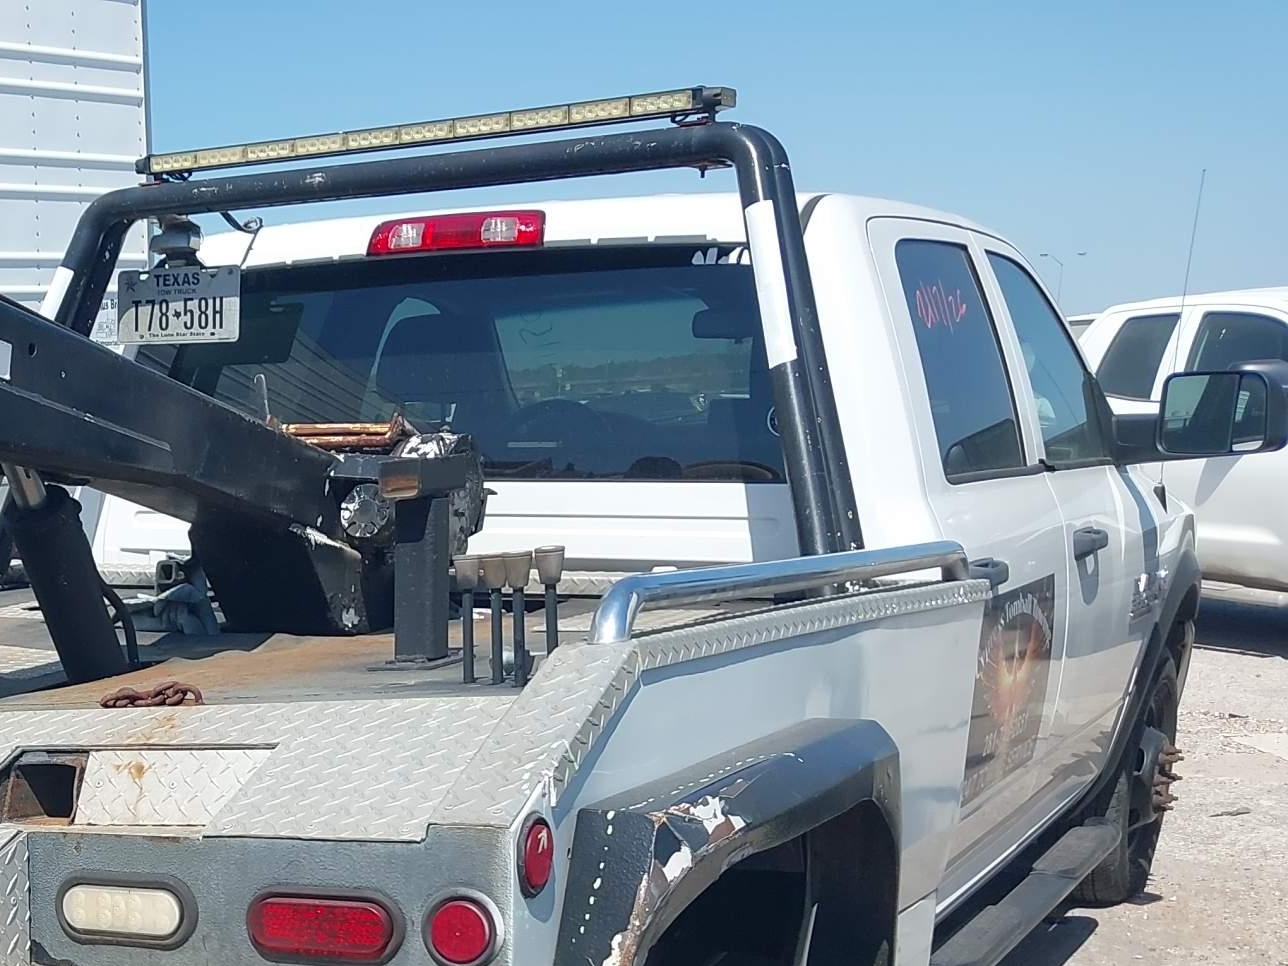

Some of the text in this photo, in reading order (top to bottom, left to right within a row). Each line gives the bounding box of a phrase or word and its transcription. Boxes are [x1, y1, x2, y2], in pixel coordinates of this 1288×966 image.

[154, 272, 200, 288] TEXAS
[157, 287, 197, 296] TOW TRUCK
[132, 296, 224, 333] T78 58H
